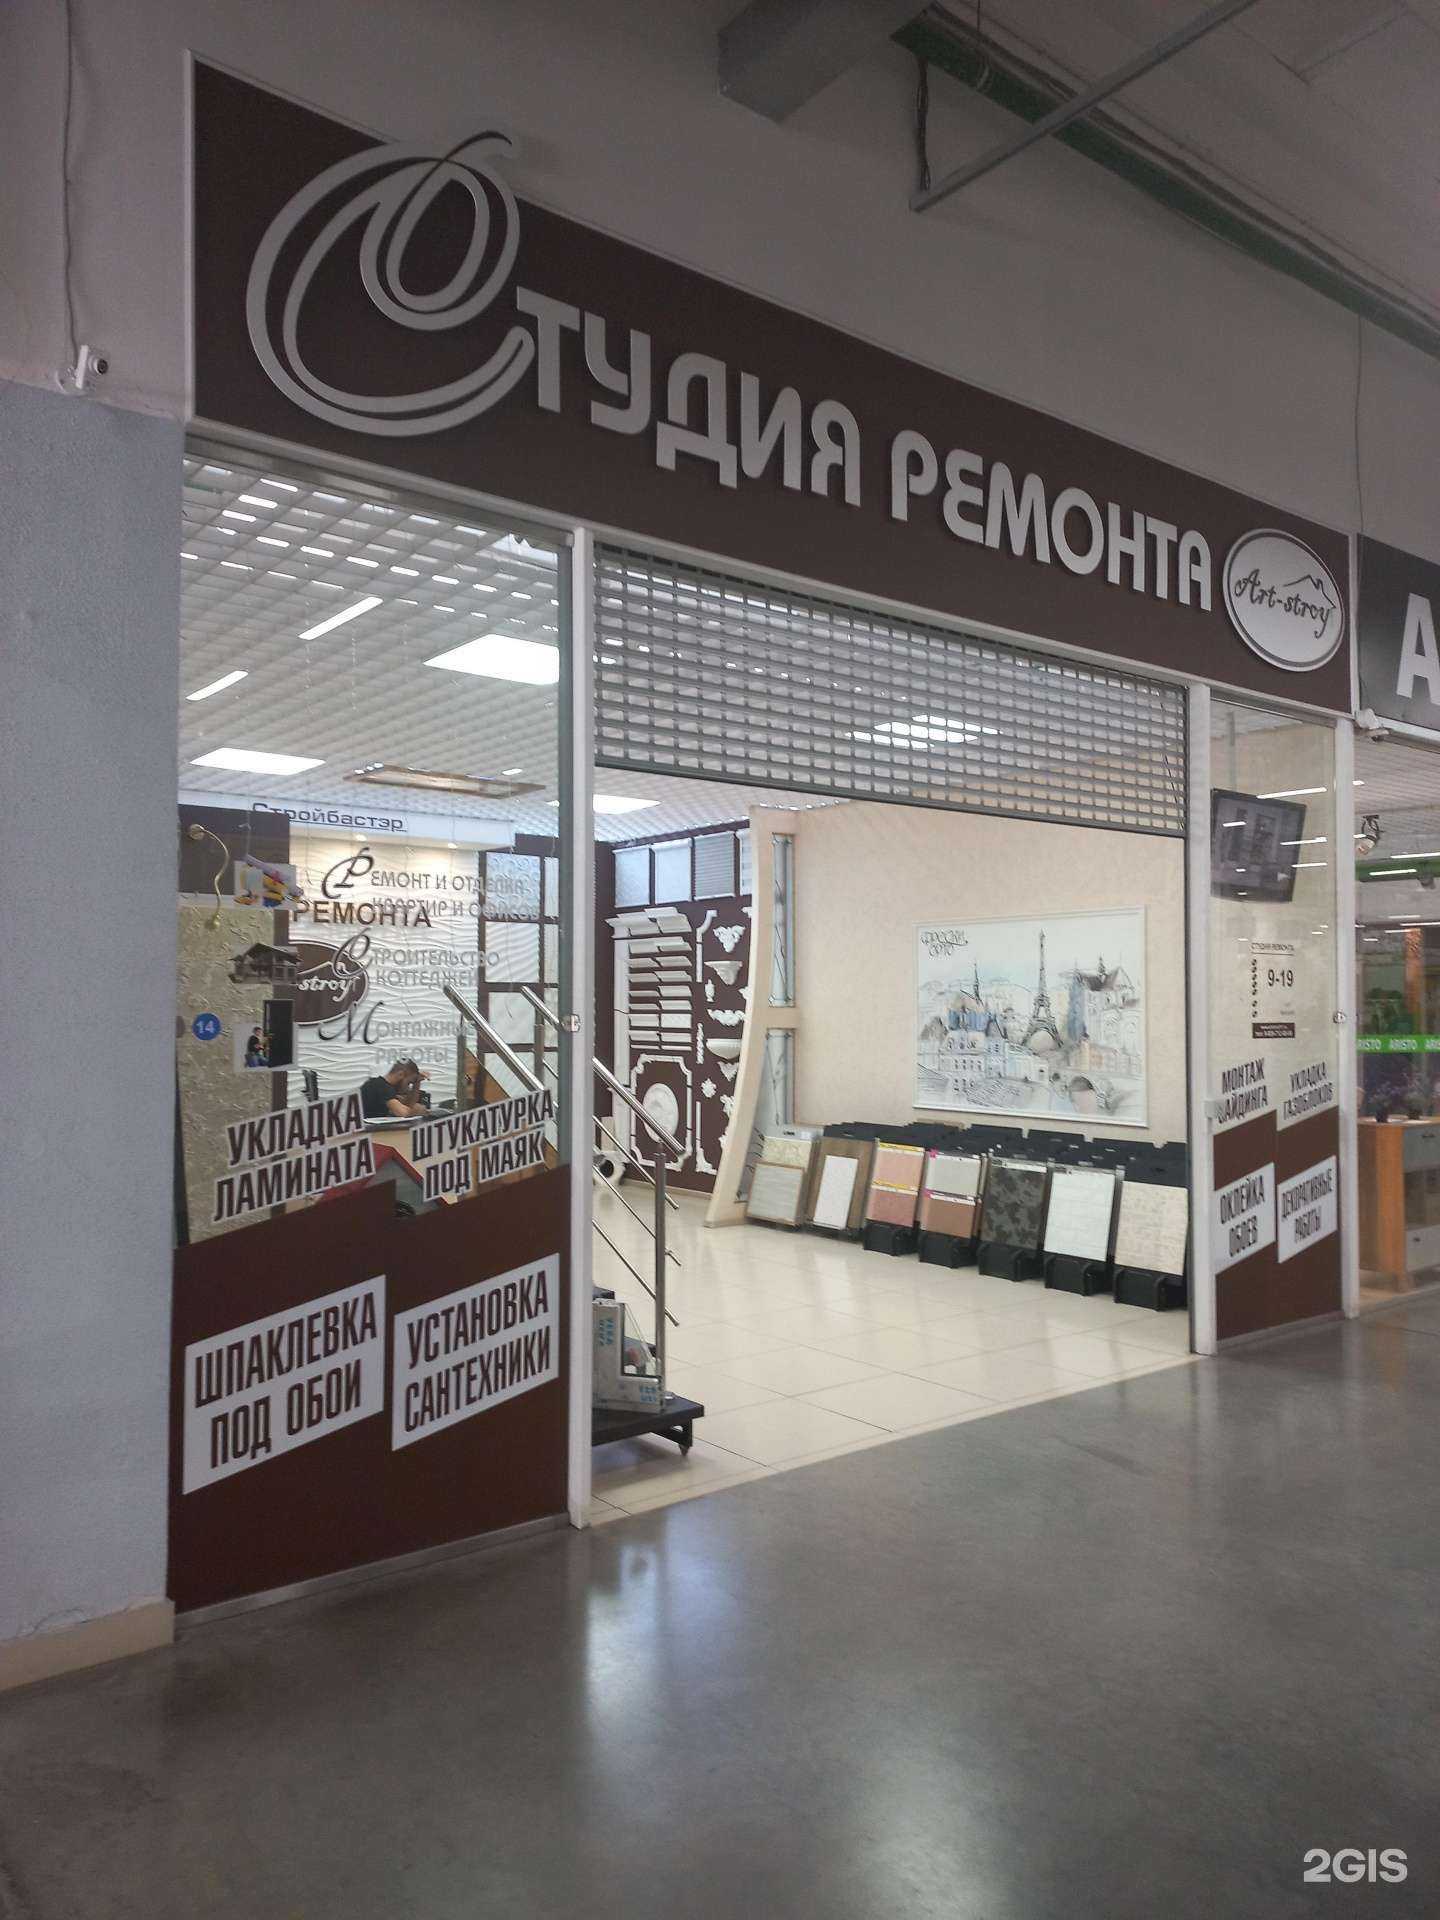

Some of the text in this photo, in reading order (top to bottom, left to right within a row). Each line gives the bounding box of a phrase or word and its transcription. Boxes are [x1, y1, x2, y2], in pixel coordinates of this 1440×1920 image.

[891, 430, 1212, 611] РЕМОНТА
[1234, 569, 1331, 639] Art-stroy
[1267, 968, 1294, 988] 9-19
[1222, 1057, 1265, 1095] МОНТАЖ
[227, 1093, 363, 1166] УКЛАДКА
[411, 1089, 554, 1162] ШТУКАТУРКА
[213, 1138, 374, 1222] ЛАМИНАТА
[425, 1130, 542, 1199] ПОД МАЯК
[1220, 1174, 1266, 1225] ОКЛЕЙКА
[1229, 1214, 1258, 1258] ОБОЕВ
[194, 1291, 378, 1409] ШПАКЛЕВКА
[406, 1269, 550, 1370] УСТАНОВКА
[210, 1358, 362, 1470] ПОД ОБОИ
[404, 1325, 551, 1433] САНТЕХНИКИ
